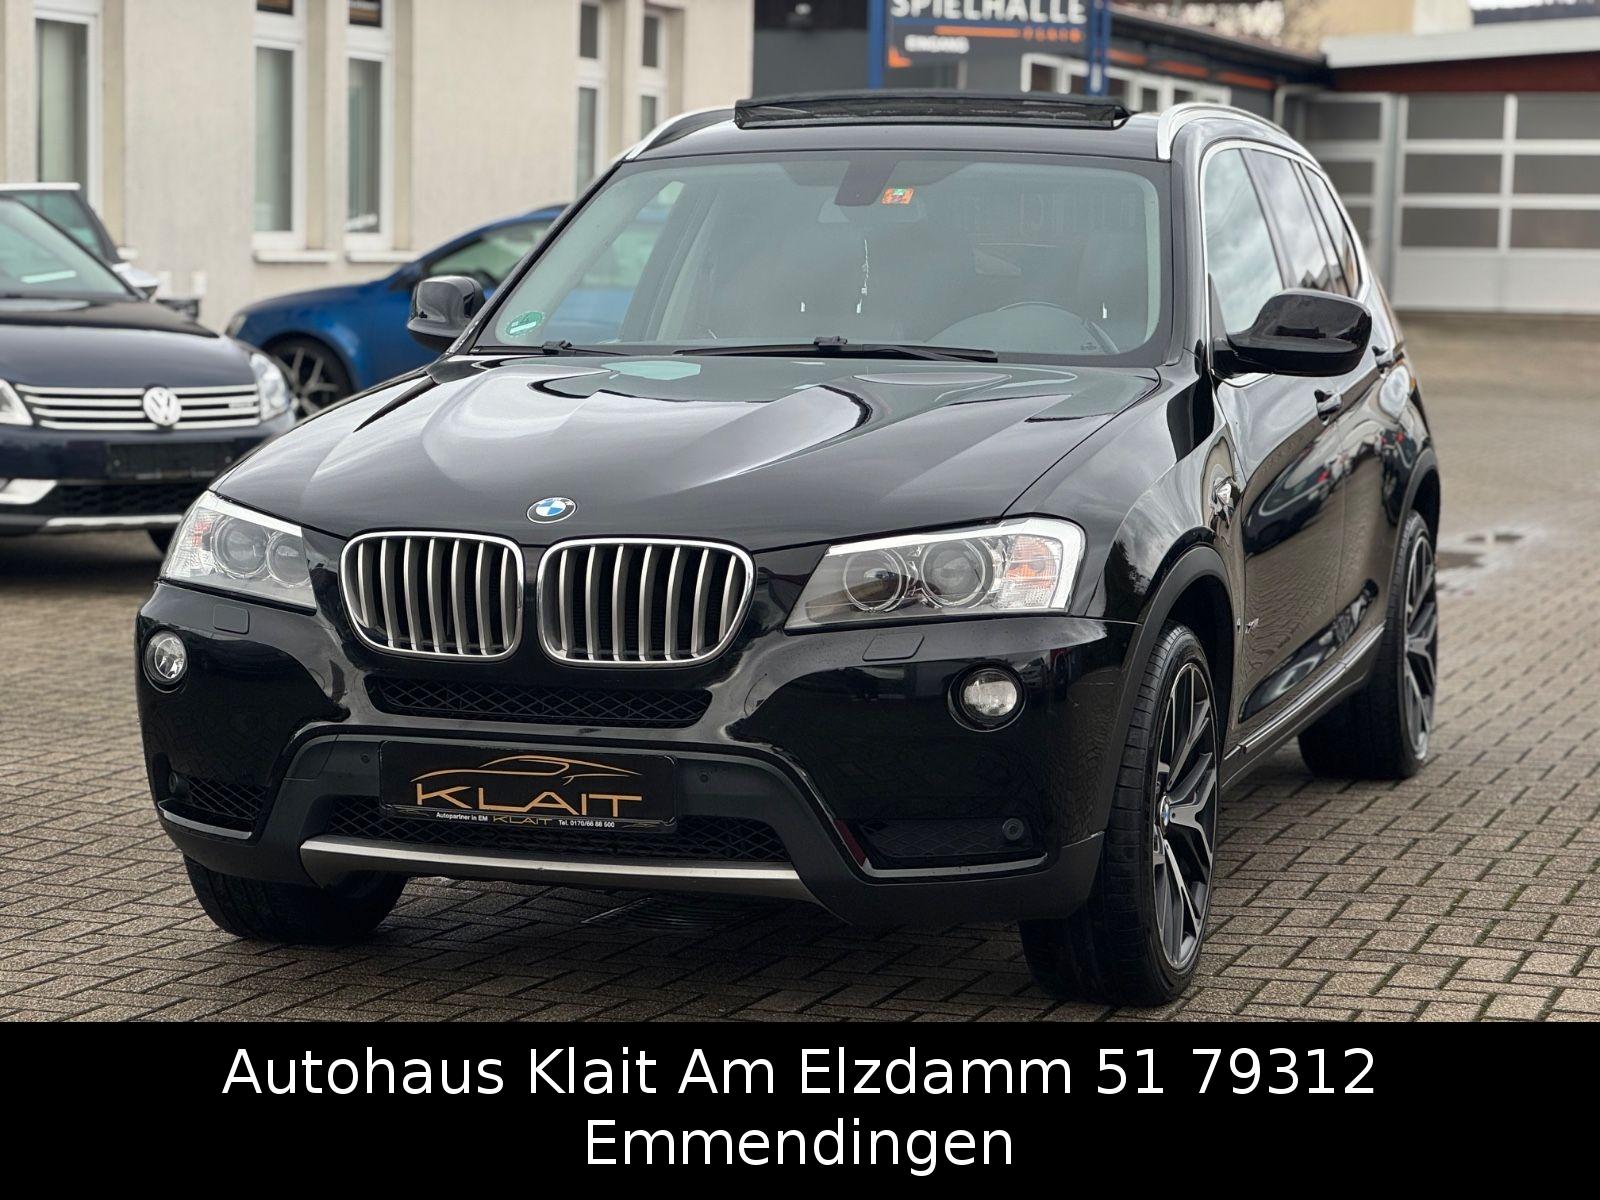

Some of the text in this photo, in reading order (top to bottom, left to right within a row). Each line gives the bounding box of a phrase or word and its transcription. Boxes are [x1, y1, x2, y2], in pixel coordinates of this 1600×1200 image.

[890, 0, 1087, 24] SPIELHALLE
[416, 783, 642, 818] KLAIT
[436, 811, 471, 821] Autopartner
[493, 815, 552, 826] KLAIT
